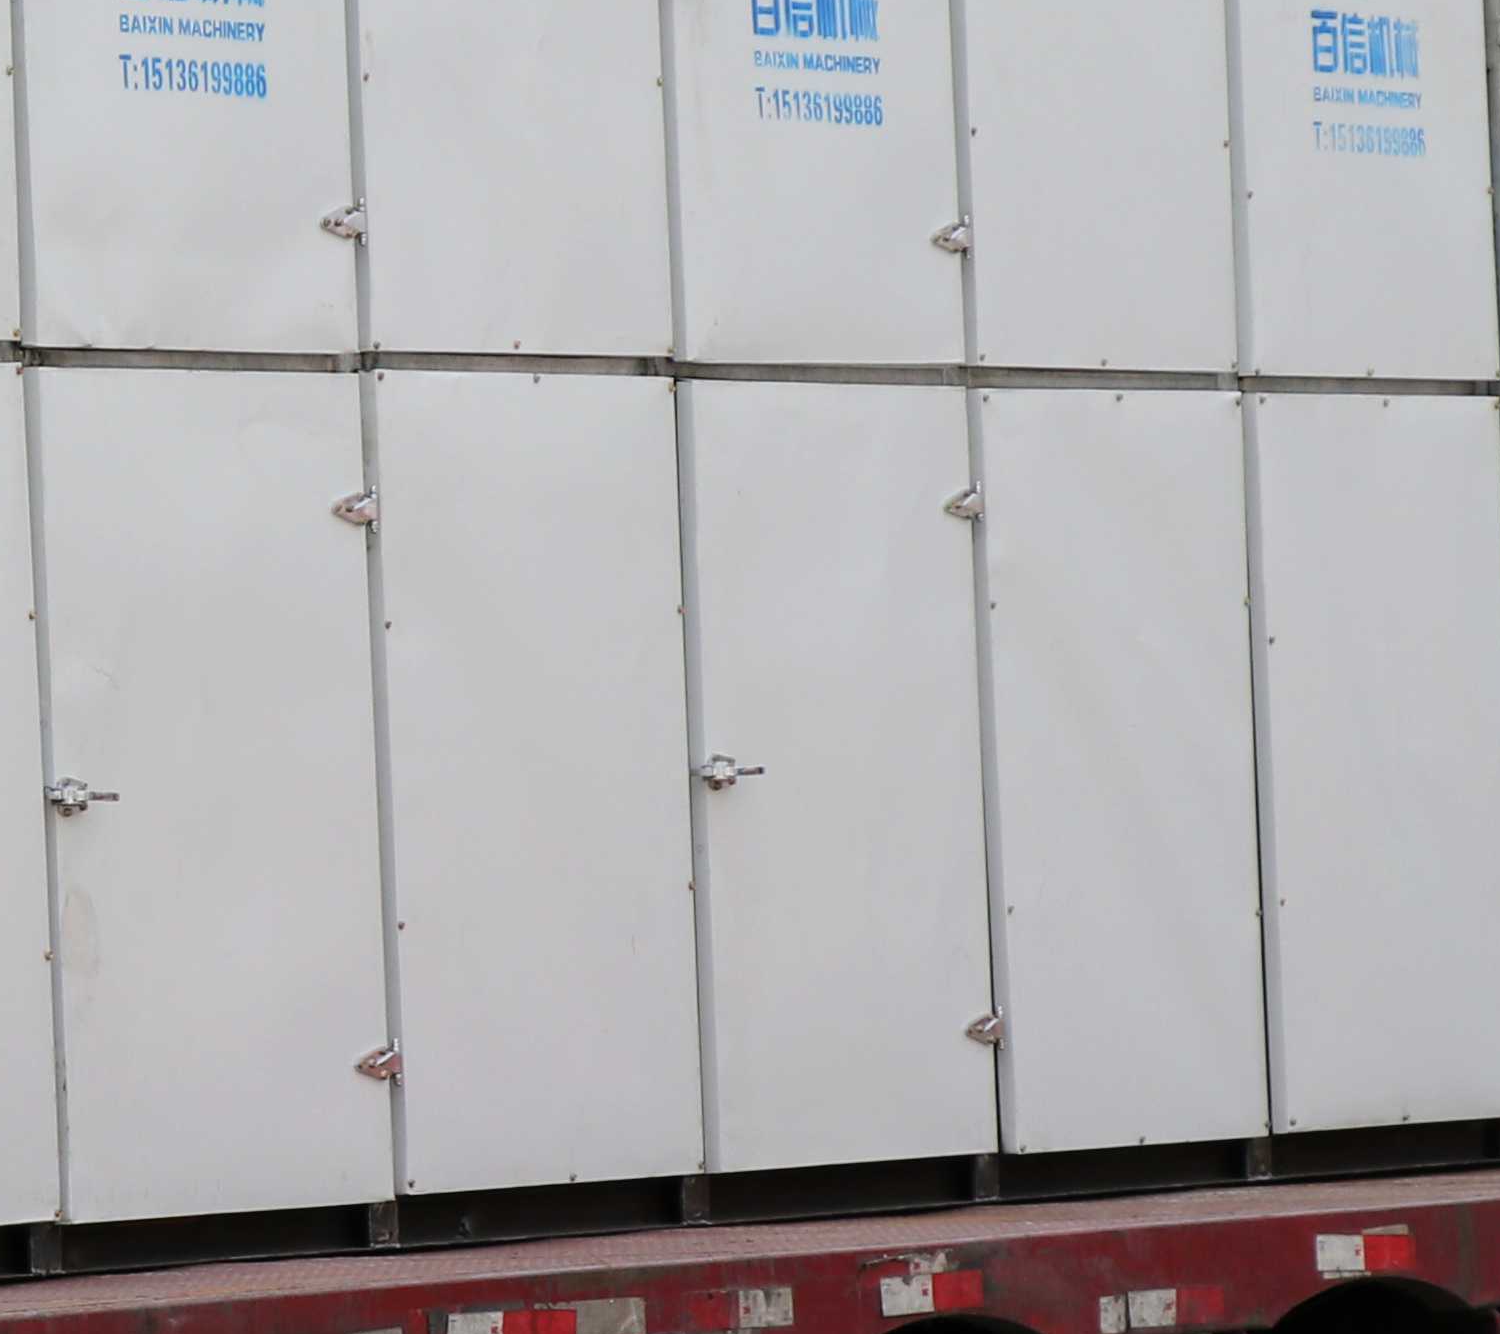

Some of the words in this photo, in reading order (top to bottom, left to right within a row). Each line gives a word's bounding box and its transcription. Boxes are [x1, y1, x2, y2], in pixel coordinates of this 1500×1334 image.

[119, 13, 173, 37] BAIXIN
[178, 17, 265, 43] MACHINERY
[118, 53, 268, 101] T:15136199886
[754, 50, 799, 71] BAIXIN
[803, 53, 881, 75] MACHINERY
[755, 87, 884, 126] T:15136199886
[1357, 88, 1422, 111] MACHINERY
